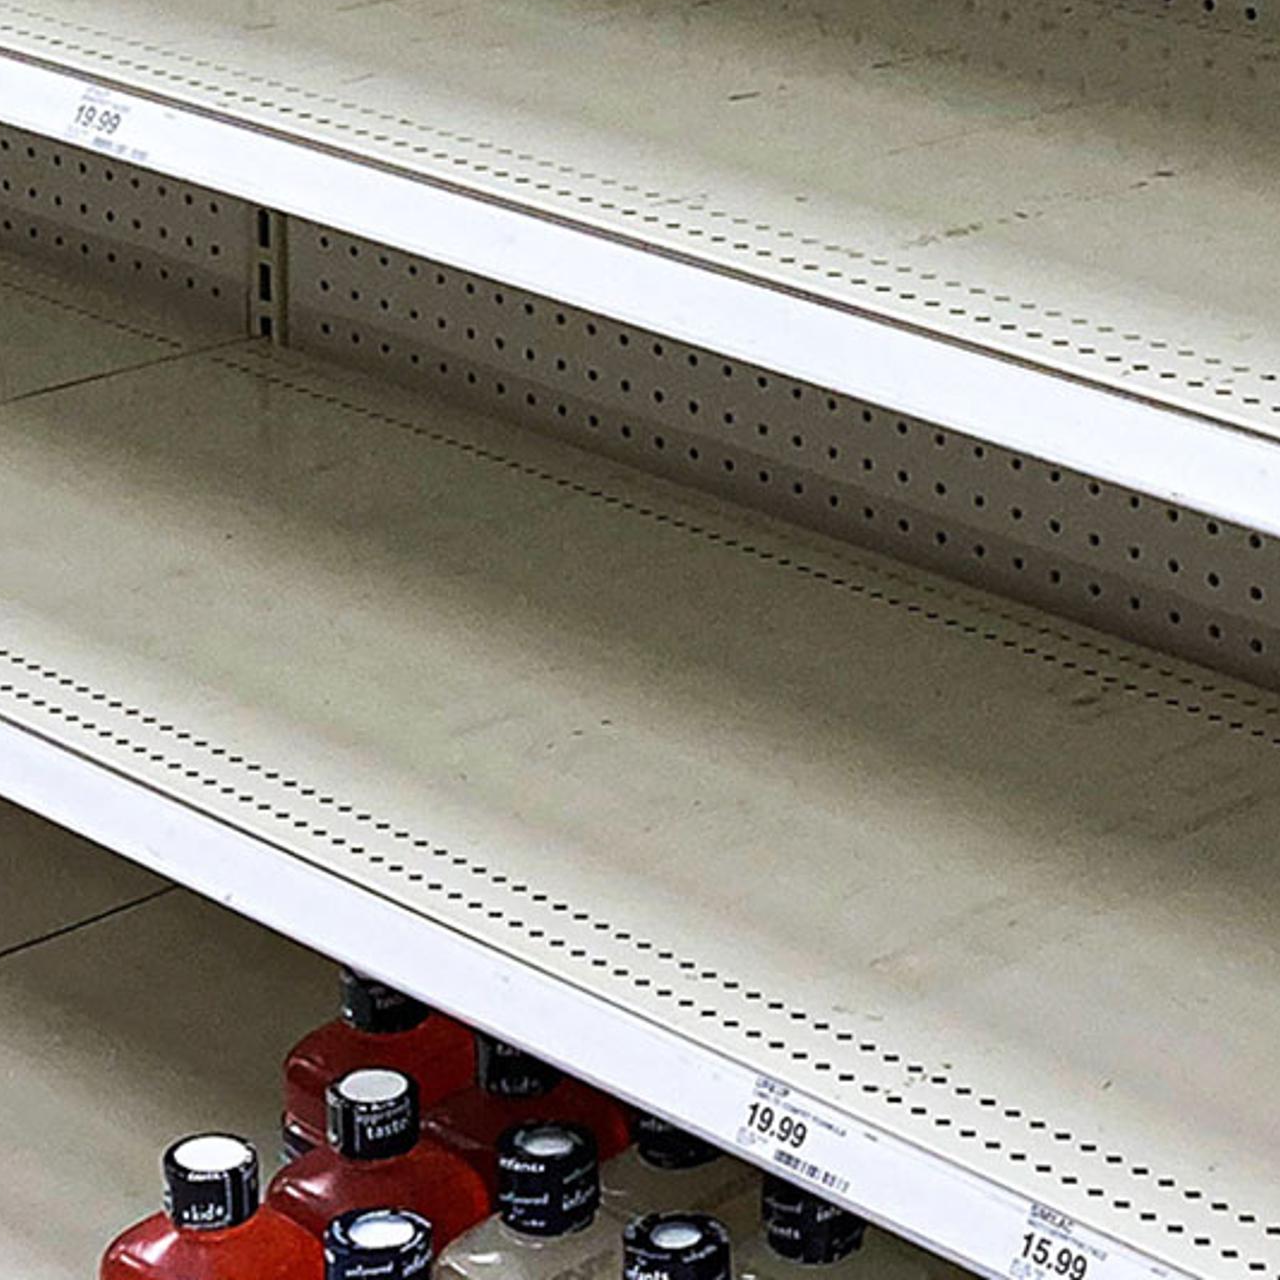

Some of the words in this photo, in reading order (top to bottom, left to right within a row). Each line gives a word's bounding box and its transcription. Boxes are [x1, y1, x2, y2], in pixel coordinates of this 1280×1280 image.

[74, 104, 122, 135] 19.99
[747, 1102, 808, 1148] 19.99
[1022, 1232, 1088, 1280] 15.99
